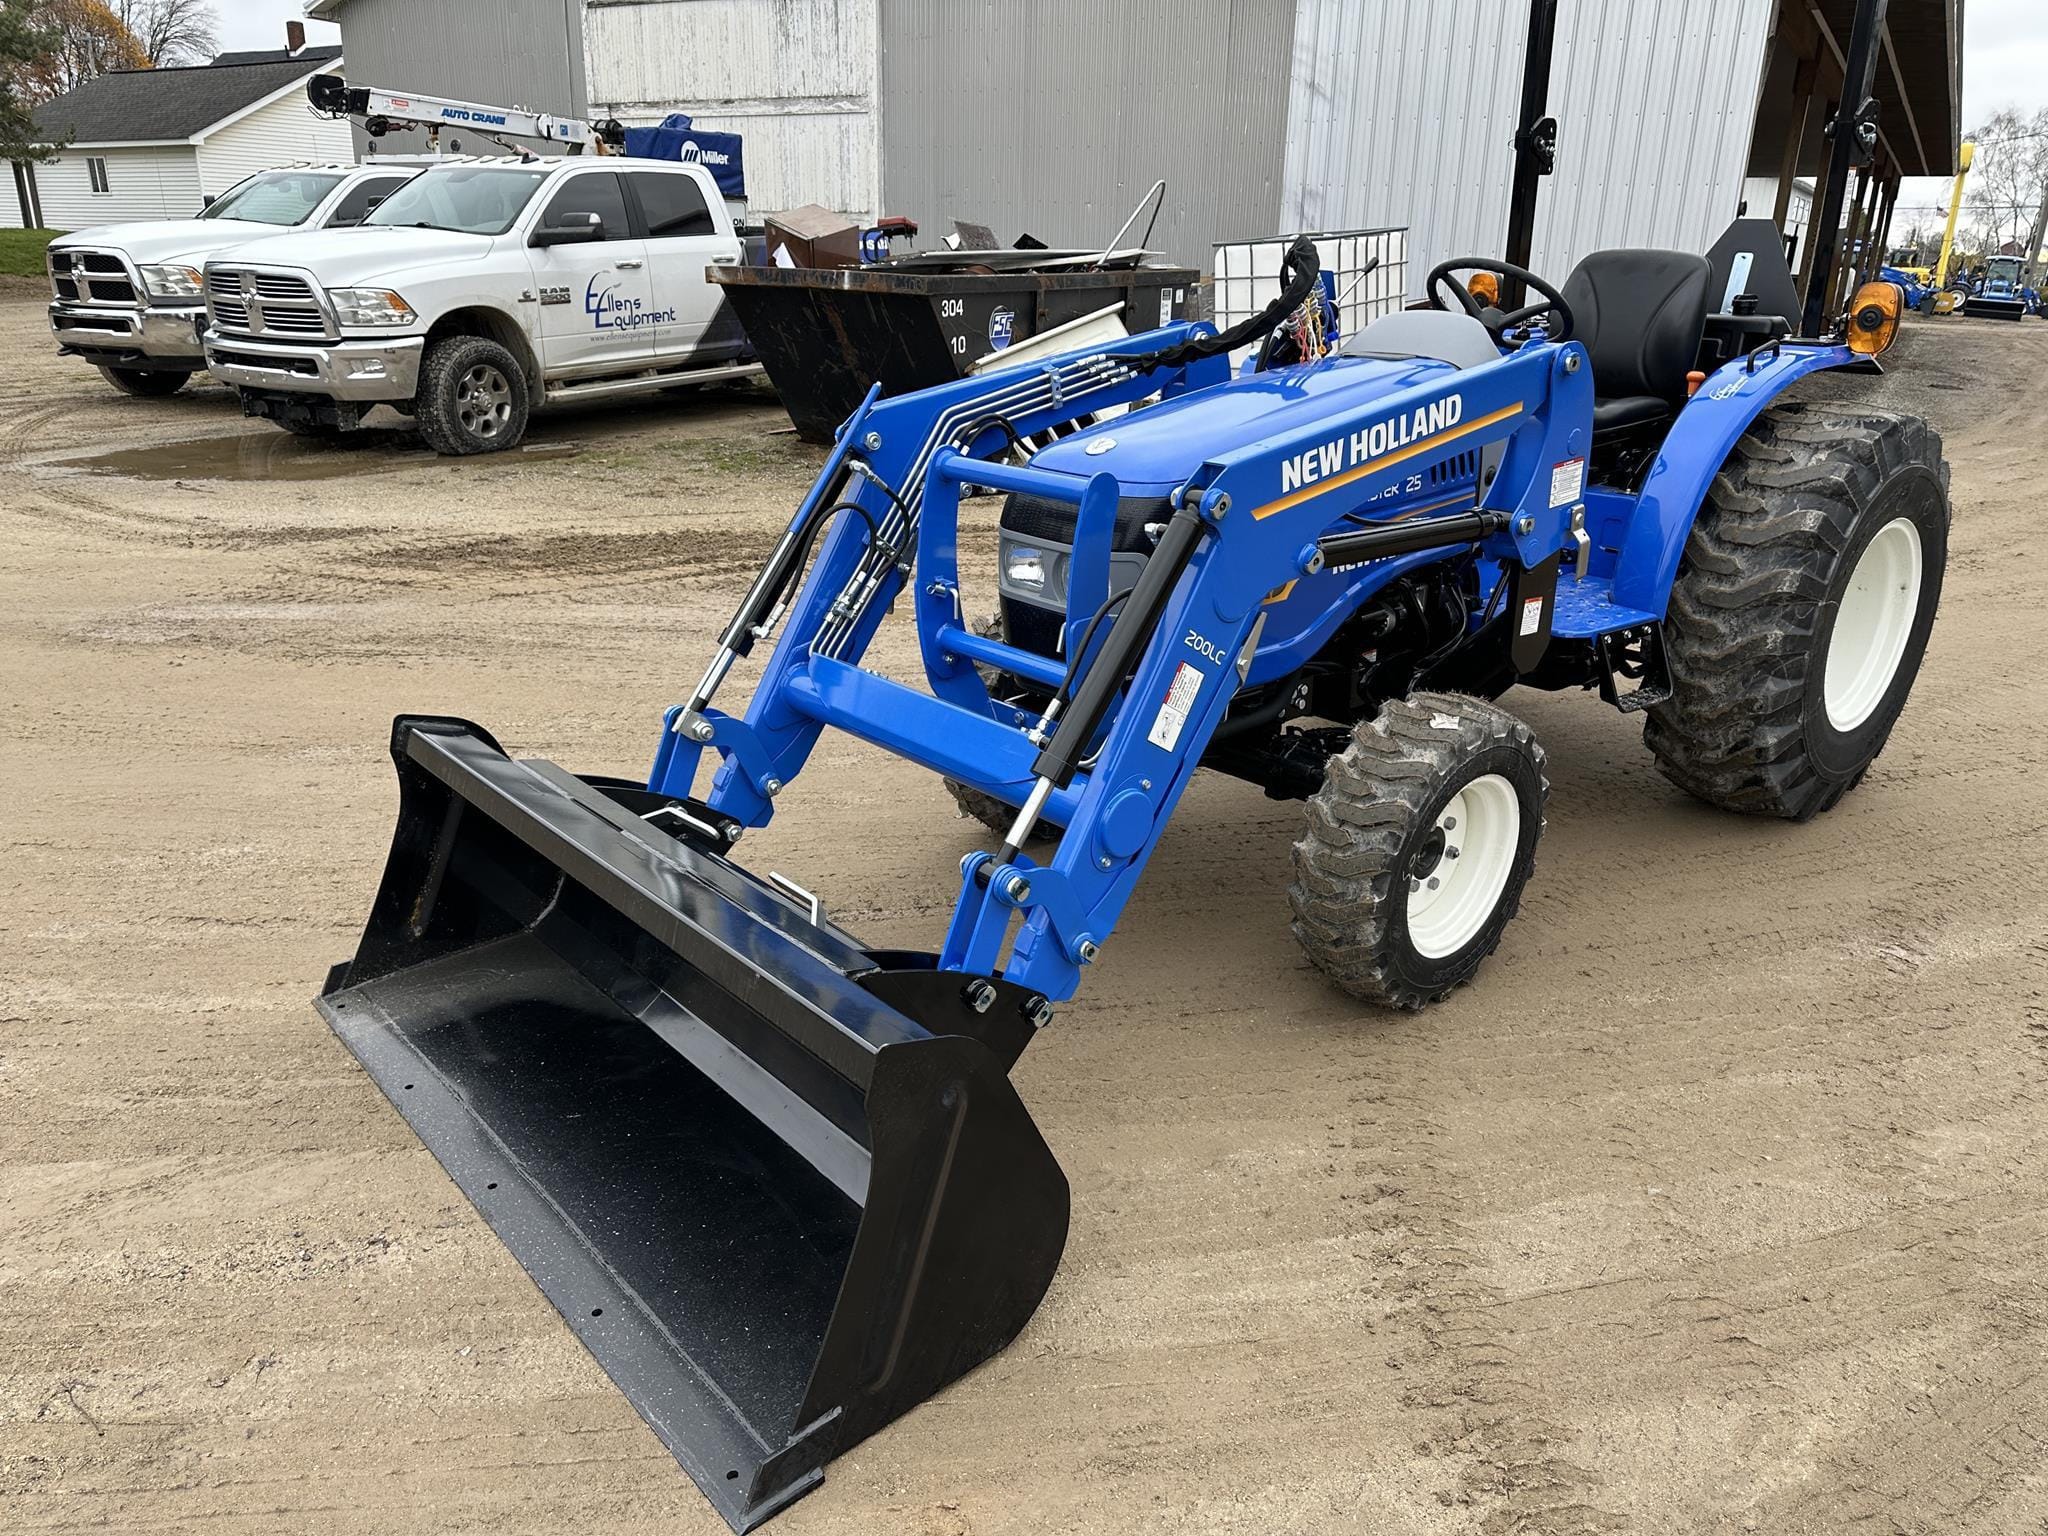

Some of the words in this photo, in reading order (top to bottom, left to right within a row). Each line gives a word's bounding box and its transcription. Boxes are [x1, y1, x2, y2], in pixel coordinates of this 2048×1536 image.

[441, 107, 470, 120] AUTO
[471, 112, 506, 125] CRANE
[701, 150, 729, 165] Miller
[538, 286, 570, 295] RAM
[585, 270, 641, 314] Ellens
[941, 299, 963, 318] 304
[951, 336, 966, 354] 10
[1282, 438, 1344, 493] NEW
[1350, 393, 1462, 466] HOLLAND
[1405, 474, 1423, 493] 25
[1184, 629, 1226, 666] 200LC
